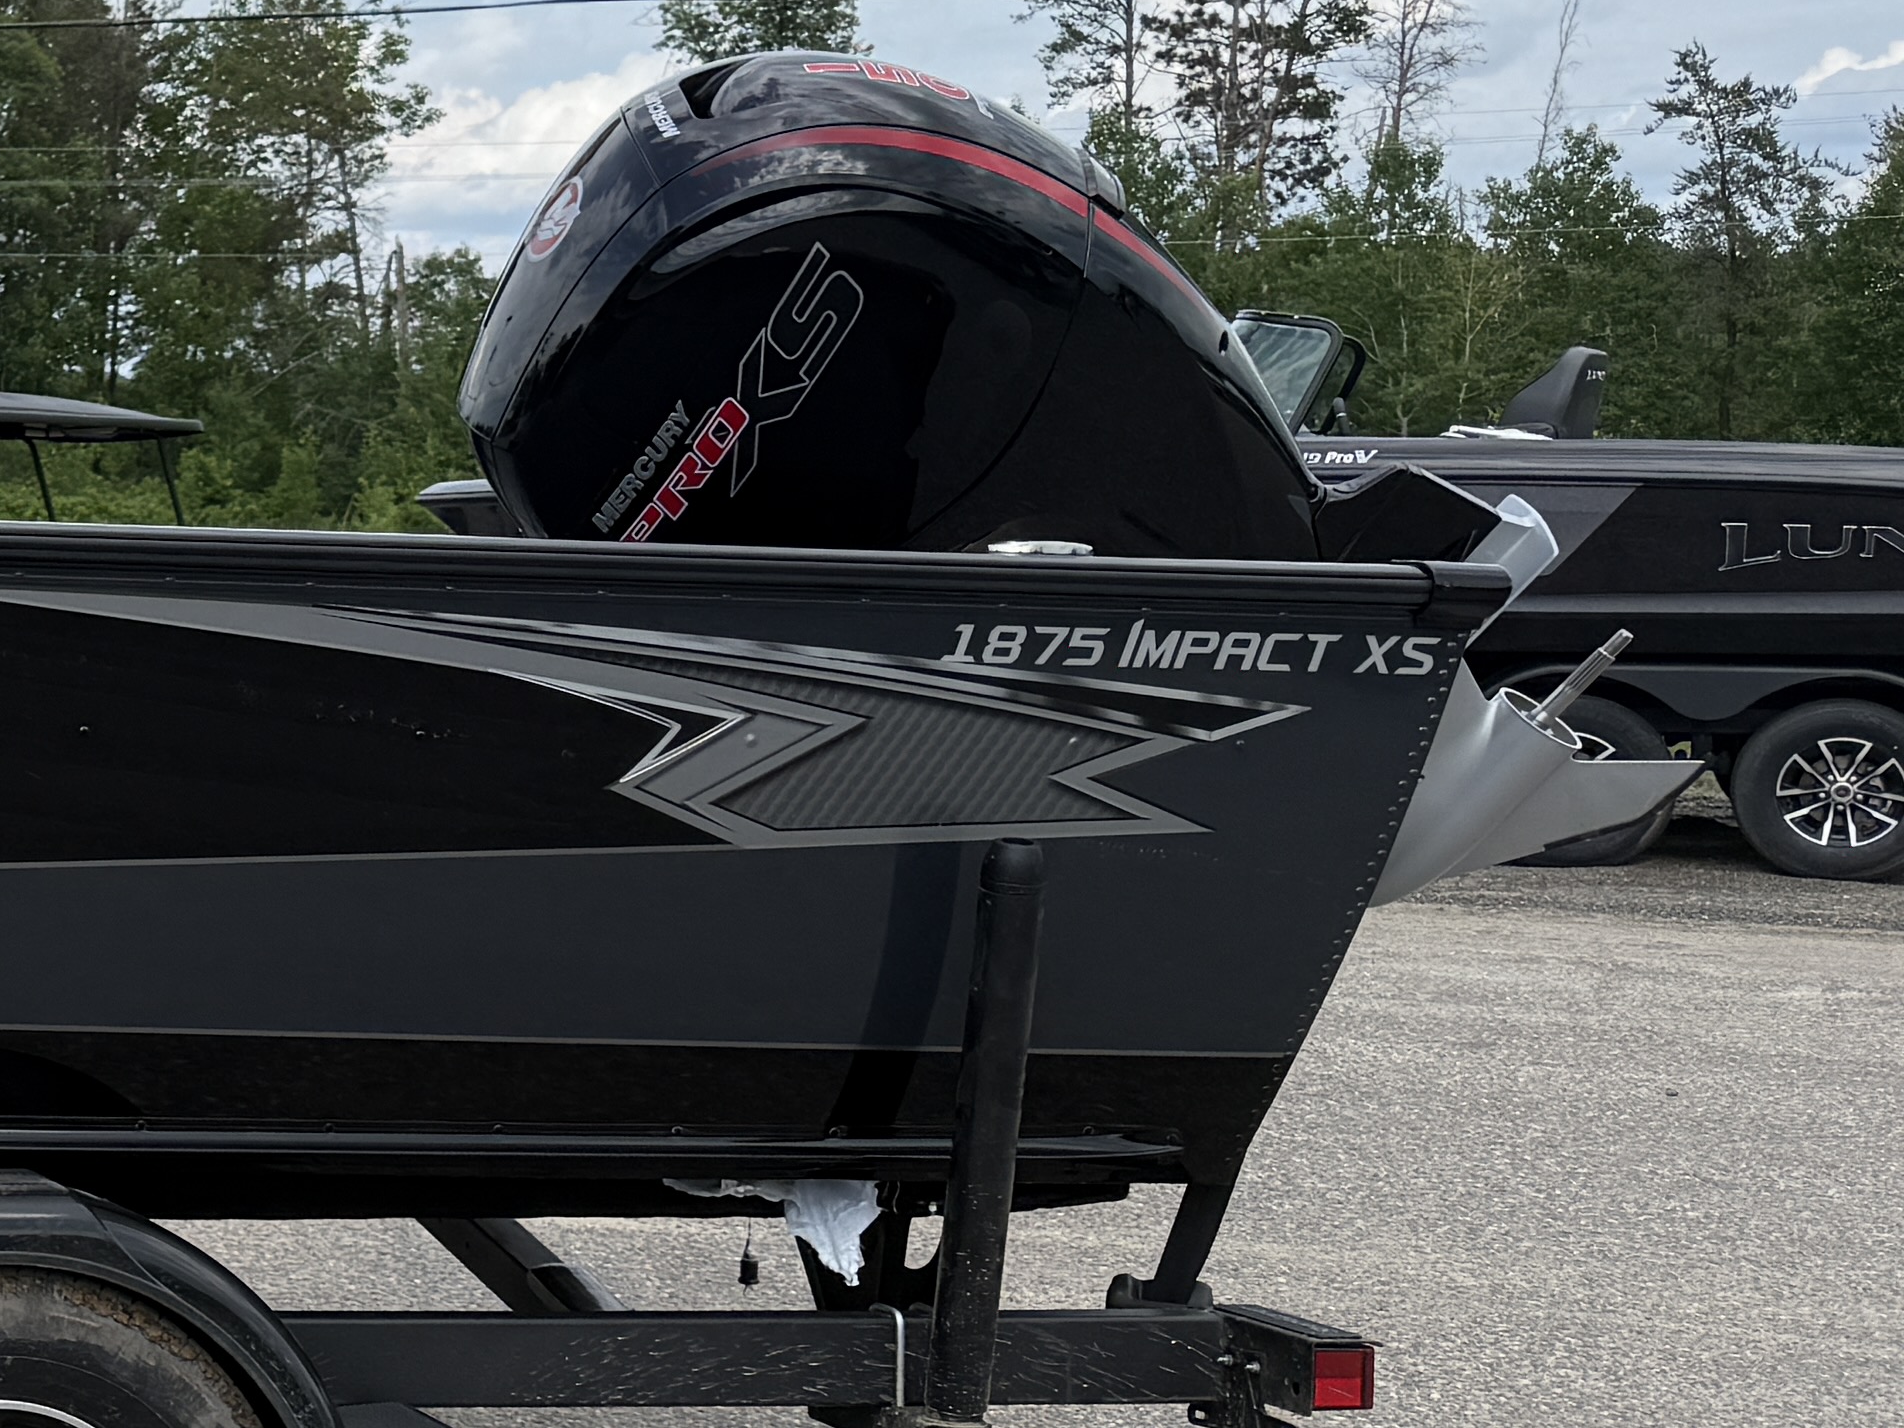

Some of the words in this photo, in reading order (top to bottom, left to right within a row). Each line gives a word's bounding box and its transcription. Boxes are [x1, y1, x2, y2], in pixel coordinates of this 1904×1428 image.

[619, 397, 749, 542] PRO
[730, 241, 864, 497] XS
[592, 399, 690, 533] MERCURY
[940, 623, 1111, 666] 1875
[1118, 618, 1343, 673] IMPACT
[1353, 634, 1443, 676] XS
